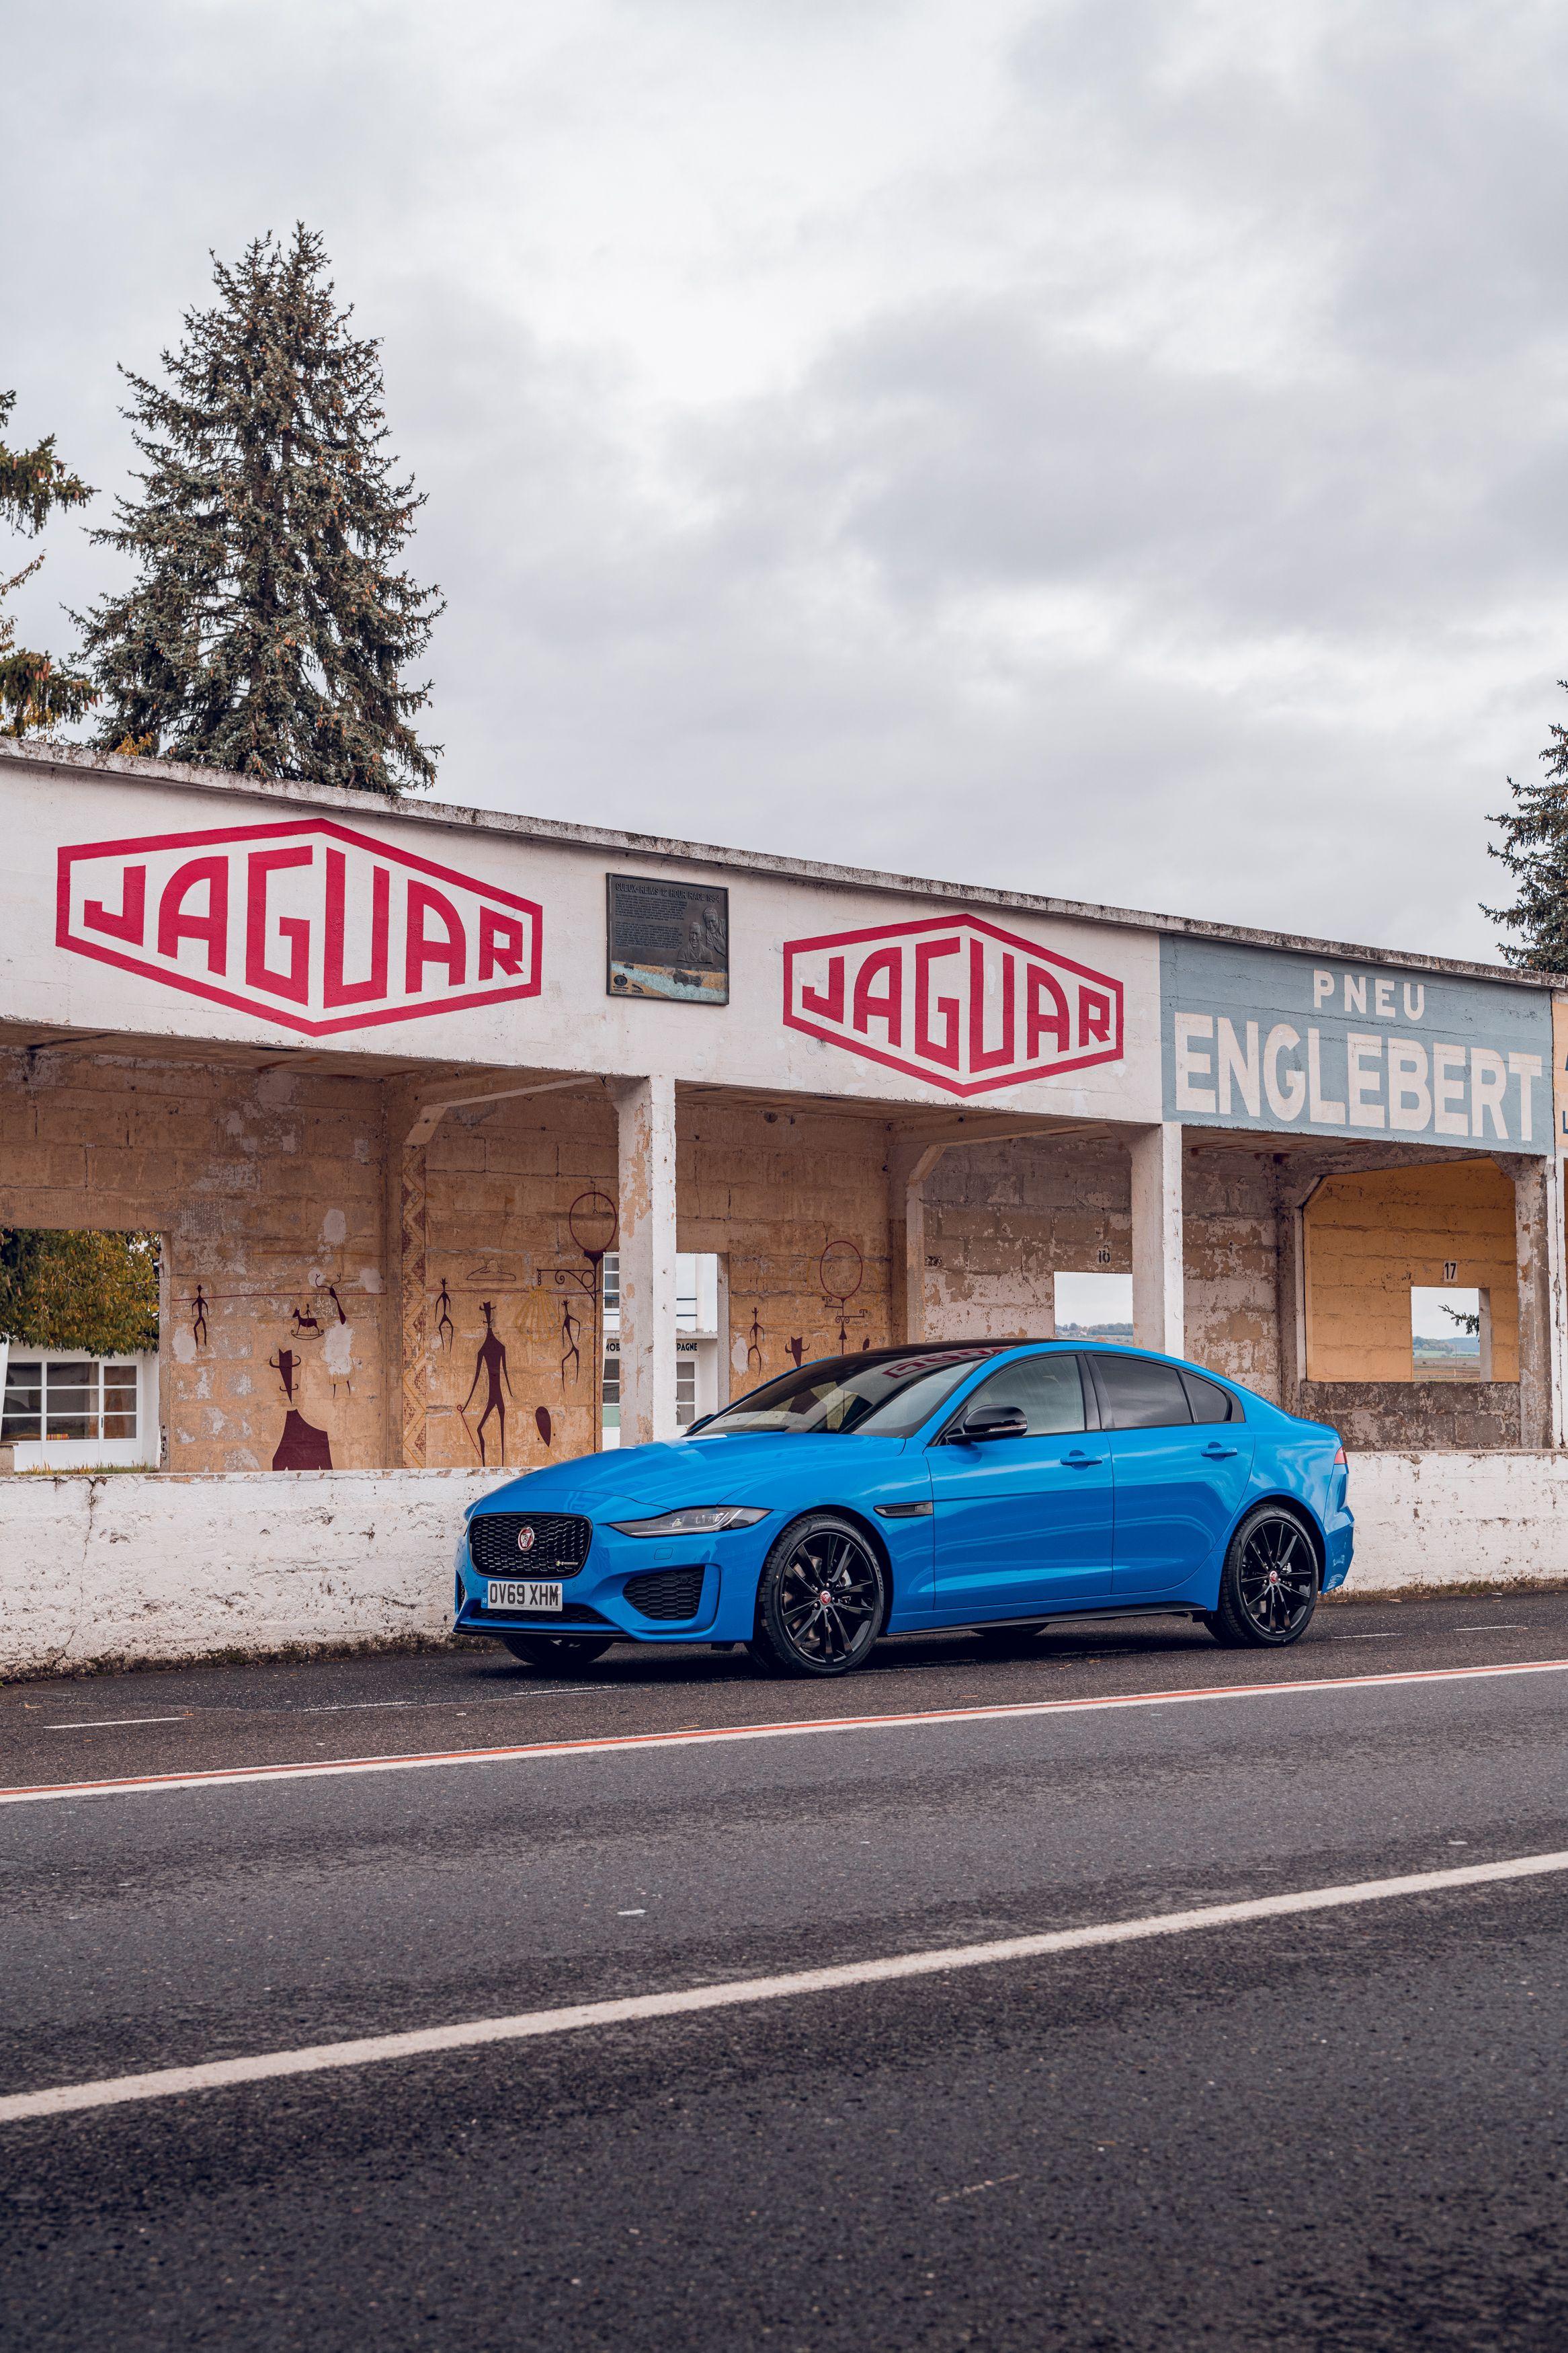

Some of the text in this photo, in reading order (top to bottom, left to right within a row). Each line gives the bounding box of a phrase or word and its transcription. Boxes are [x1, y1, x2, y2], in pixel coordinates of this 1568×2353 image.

[616, 882, 658, 895] GUEUX-REIMS
[661, 888, 667, 898] 12
[669, 889, 687, 899] HOUR
[688, 892, 704, 902] RACE
[83, 845, 524, 1008] JAGUAR
[802, 936, 1111, 1074] JAGUAR
[1313, 969, 1425, 1021] PNEU
[1174, 1011, 1542, 1142] ENGLEBERT
[1444, 1263, 1456, 1279] 17
[677, 1343, 698, 1351] PAGNE
[489, 1583, 559, 1606] OV69 XHM
